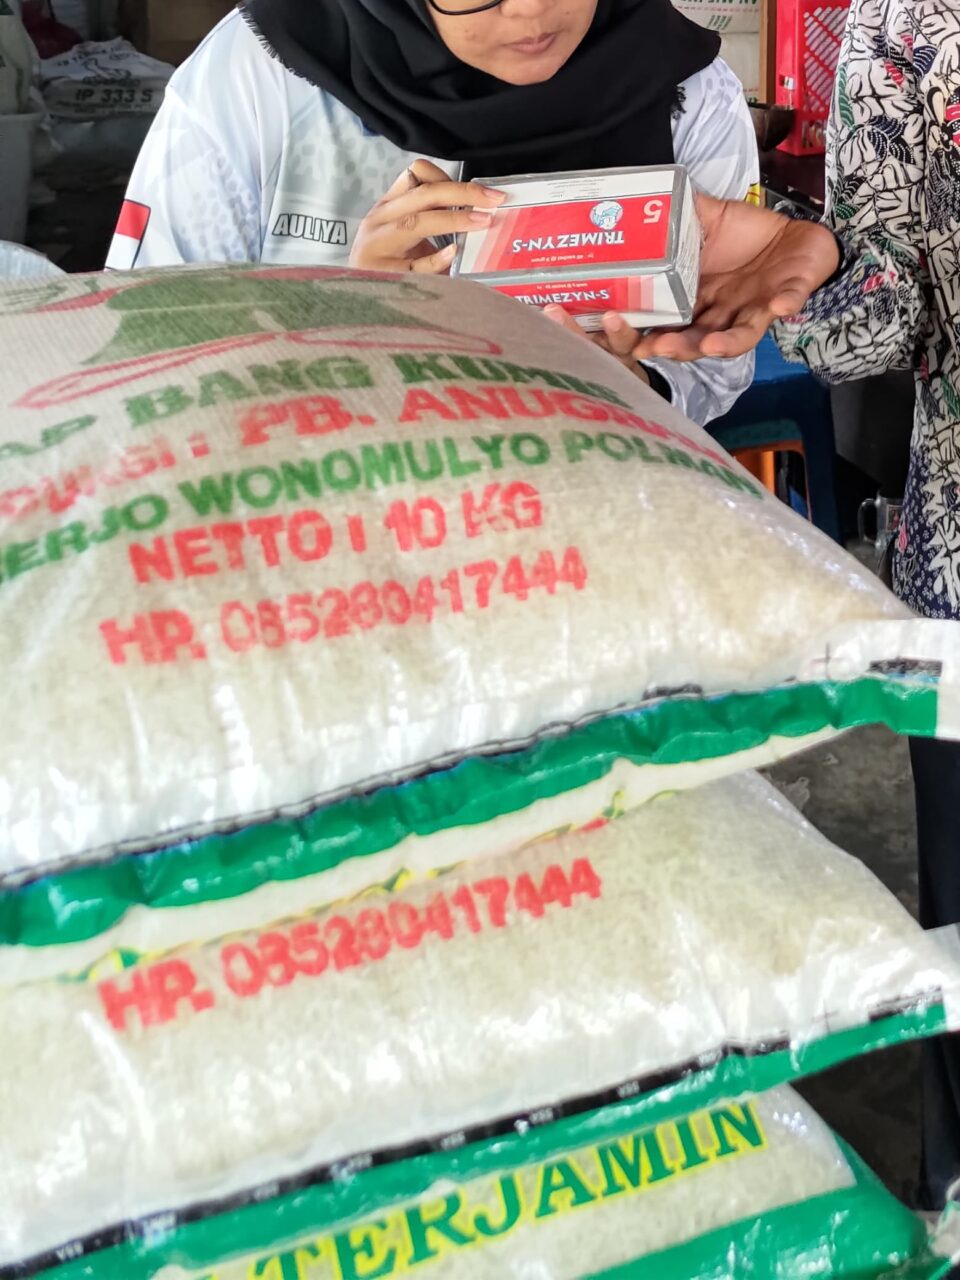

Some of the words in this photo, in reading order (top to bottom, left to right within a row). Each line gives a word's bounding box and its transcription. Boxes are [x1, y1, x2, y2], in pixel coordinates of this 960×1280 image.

[101, 88, 135, 103] 333
[141, 88, 153, 103] S
[643, 199, 664, 224] 5
[271, 213, 348, 246] AULIYA
[512, 230, 625, 254] TRIMEZYN-S
[514, 289, 610, 305] TRIMEZYN-S
[123, 356, 374, 429] BANG
[177, 430, 551, 518] WONOMULYO
[127, 509, 335, 584] NETTO
[383, 496, 447, 553] 10
[460, 480, 544, 539] KG
[253, 1094, 767, 1280] TERJAMIN
